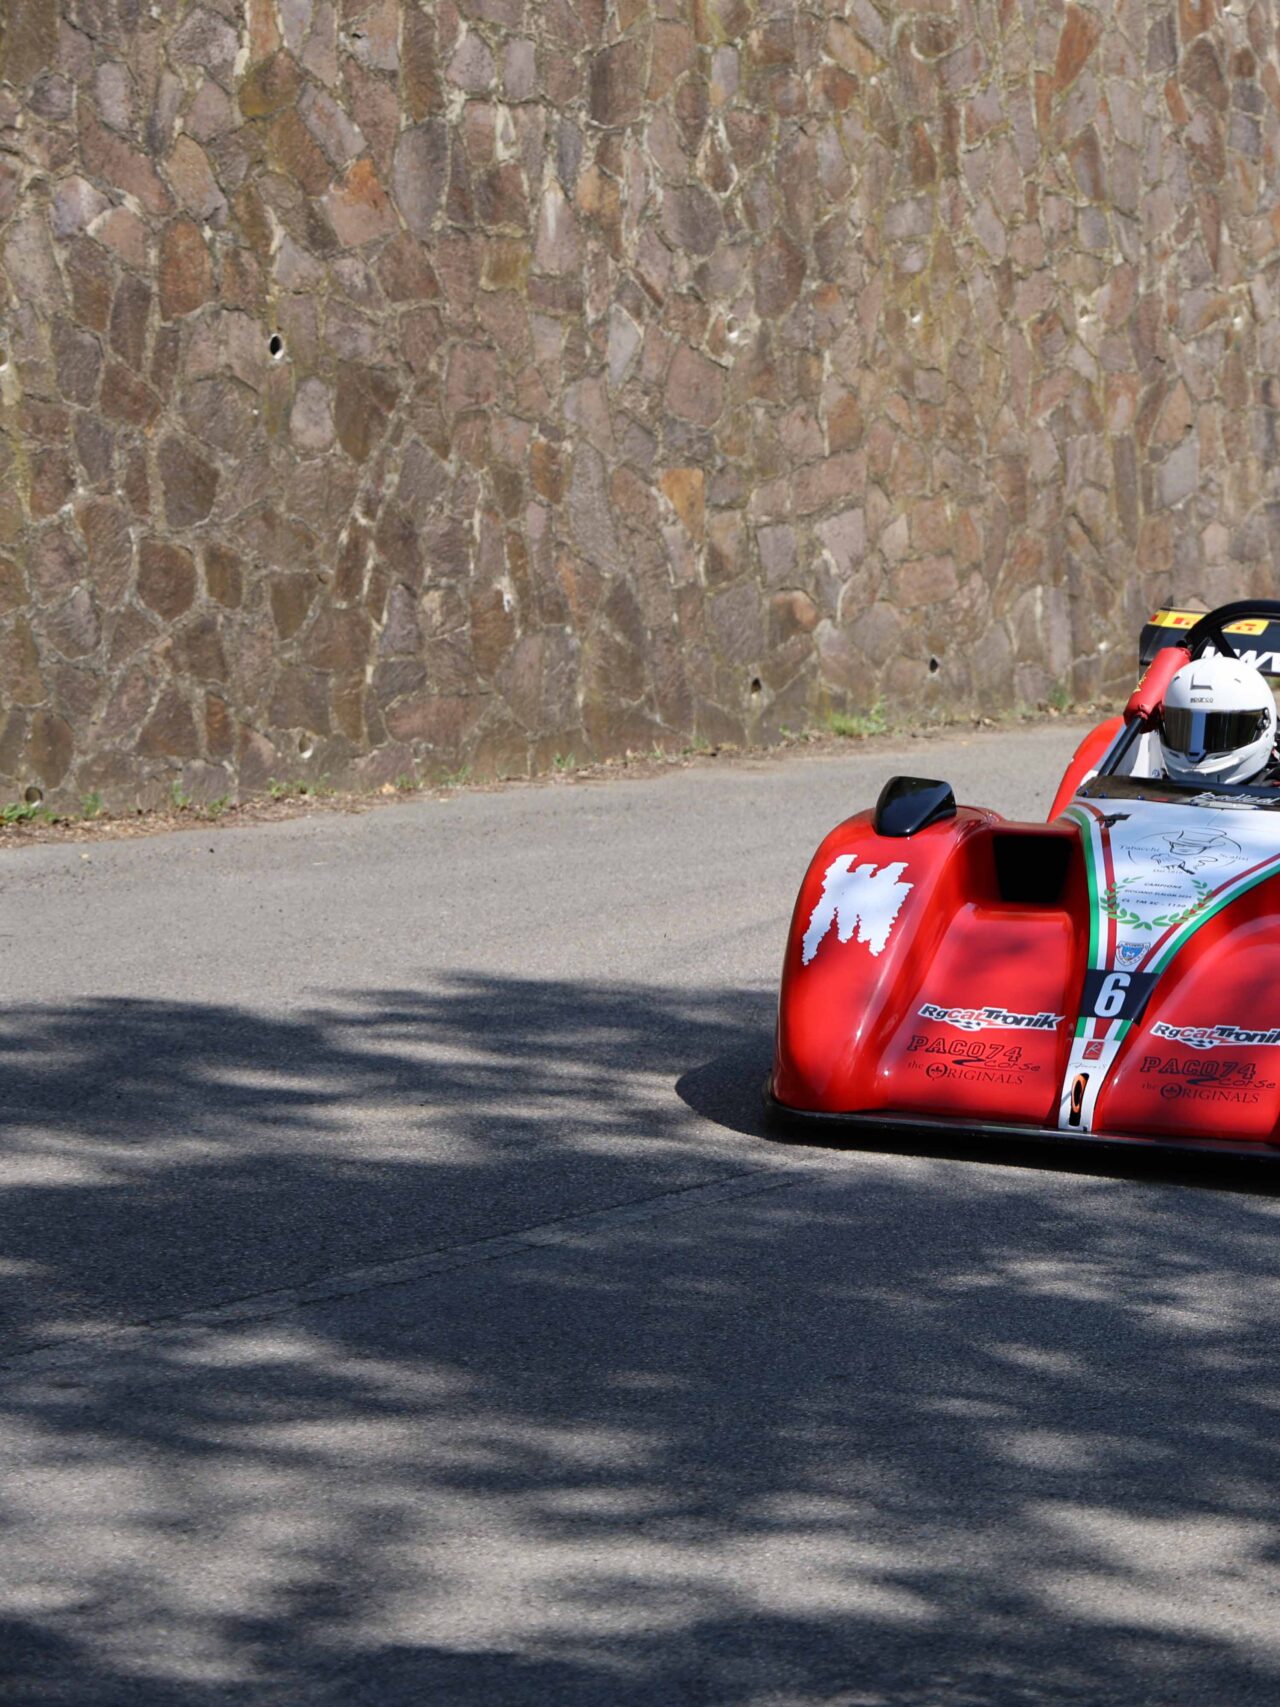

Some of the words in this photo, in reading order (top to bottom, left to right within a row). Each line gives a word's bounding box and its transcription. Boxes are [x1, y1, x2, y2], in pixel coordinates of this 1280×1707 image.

[1093, 972, 1131, 1018] 6
[907, 1034, 1023, 1063] PACO74
[925, 1062, 1025, 1085] ORIGINALS
[1140, 1056, 1257, 1081] PACO74
[1160, 1082, 1260, 1104] ORIGINALS
